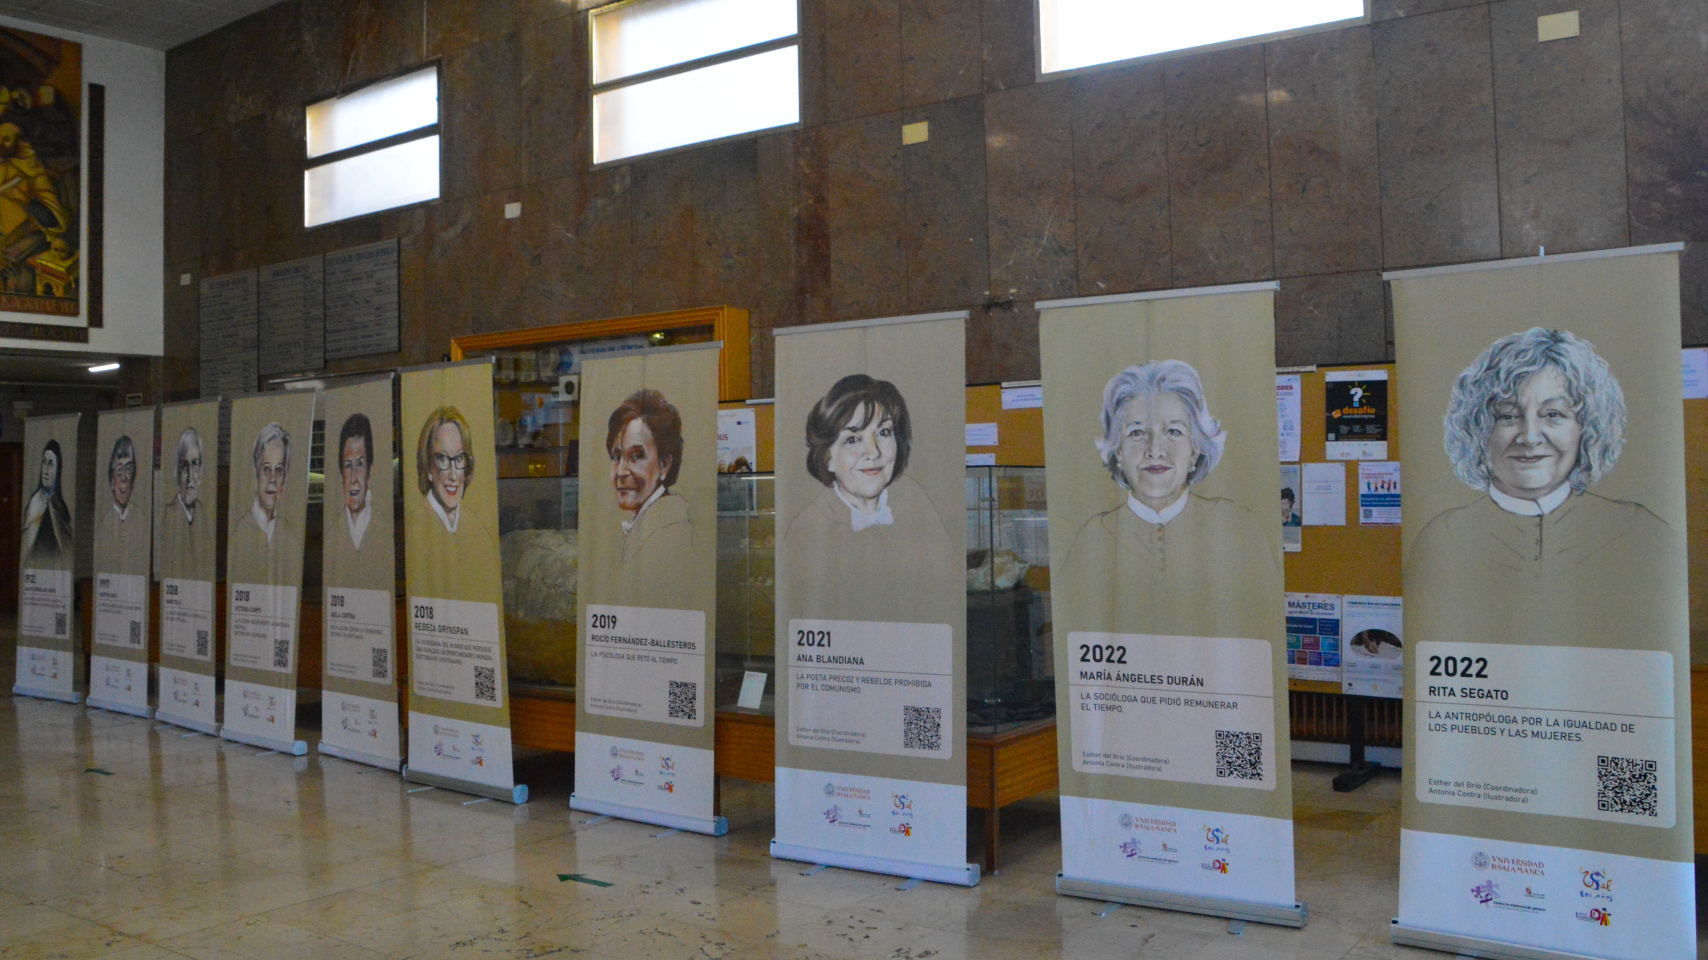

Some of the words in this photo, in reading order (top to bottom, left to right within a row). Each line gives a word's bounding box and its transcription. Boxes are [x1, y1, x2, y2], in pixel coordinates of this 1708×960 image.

[235, 590, 250, 602] 2018
[414, 605, 434, 620] 2018
[1288, 600, 1335, 611] MÁSTERES
[415, 622, 436, 632] REBECA
[438, 625, 468, 636] GRYNSPAN
[592, 614, 617, 629] 2019
[591, 634, 610, 643] ROCÍO
[611, 636, 696, 650] FERNÁNDEZ-BALLESTEROS
[797, 630, 831, 647] 2021
[796, 654, 813, 663] ANA
[816, 655, 865, 666] BLANDIANA
[1080, 644, 1127, 664] 2022
[1429, 655, 1489, 678] 2022
[862, 677, 892, 686] REBELDE
[894, 680, 932, 688] PROHIBIDA
[1080, 670, 1112, 682] MARÍA
[1116, 671, 1164, 684] ÁNGELES
[1167, 674, 1204, 687] DURÁN
[1428, 686, 1456, 698] RITA
[1460, 687, 1509, 700] SEGATO
[1094, 692, 1138, 703] SOCIÓLOGA
[1140, 696, 1157, 704] QUE
[1159, 696, 1182, 706] PIDIÓ
[1184, 699, 1238, 710] REMUNERAR
[1094, 703, 1124, 713] TIEMPO.
[1429, 711, 1442, 720] LA
[1444, 711, 1518, 724] ANTROPÓLOGA
[1522, 716, 1543, 726] POR
[1546, 717, 1560, 727] LA
[1563, 718, 1617, 732] IGUALDAD
[1621, 723, 1635, 733] DE
[1429, 723, 1448, 732] LOS
[1450, 724, 1497, 736] PUEBLOS
[1499, 726, 1506, 736] Y
[1508, 728, 1528, 738] LAS
[1531, 730, 1584, 742] MUJERES.
[1126, 755, 1170, 764] (Coordinadora)
[1126, 763, 1162, 772] (Ilustradora)
[1428, 788, 1455, 796] Antonia
[1457, 790, 1481, 798] Contra
[1483, 792, 1528, 804] (Ilustradora)
[1484, 783, 1538, 795] (Coordinadora)
